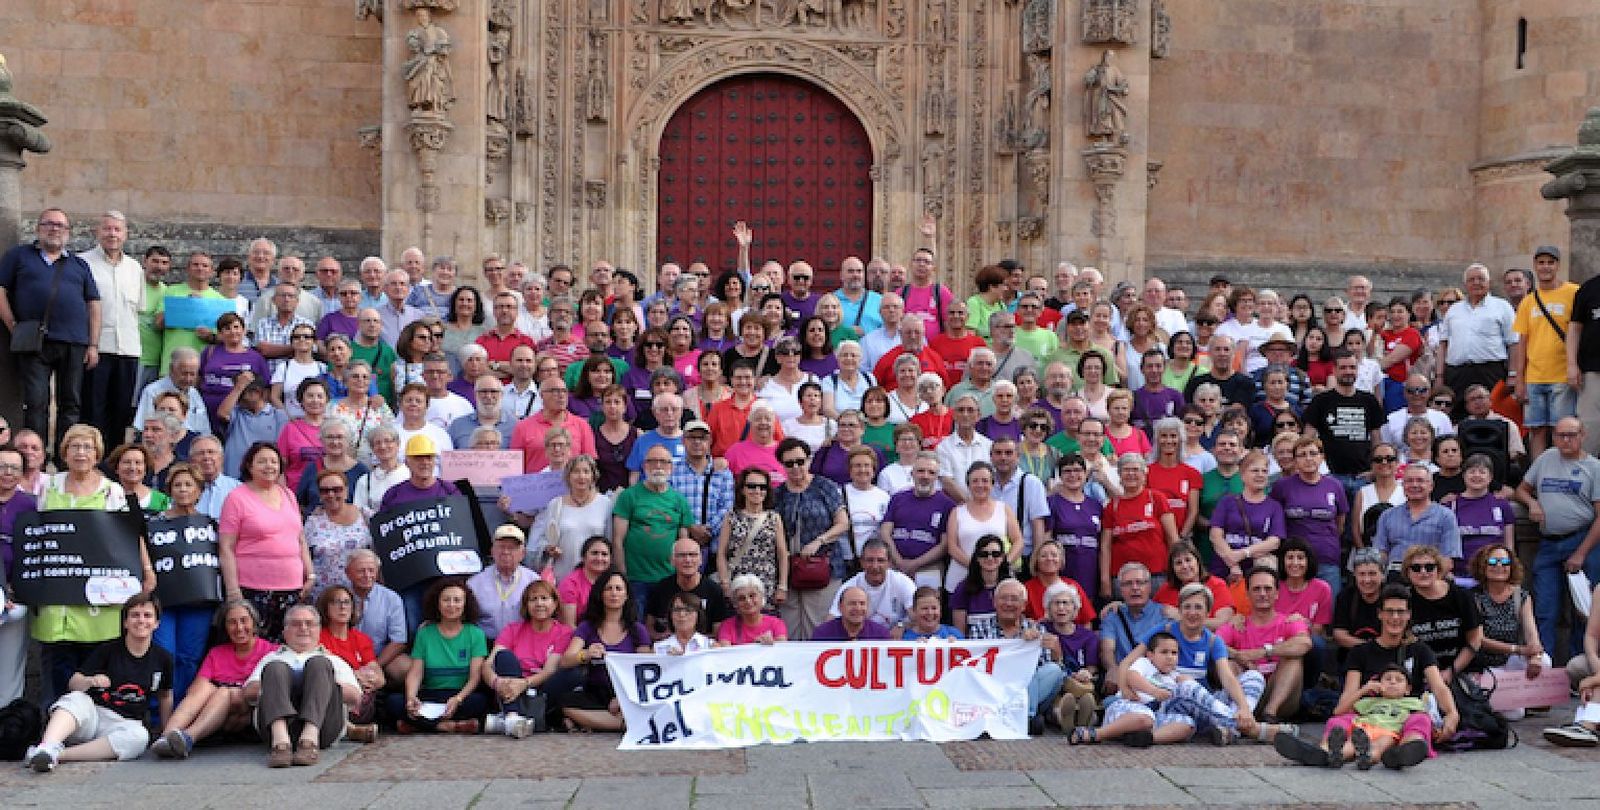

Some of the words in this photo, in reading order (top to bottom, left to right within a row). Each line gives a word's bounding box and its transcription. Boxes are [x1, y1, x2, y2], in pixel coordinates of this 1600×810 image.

[380, 504, 451, 537] producir
[403, 522, 440, 542] para
[390, 532, 462, 561] consumir
[634, 664, 694, 702] Por
[637, 701, 692, 744] del
